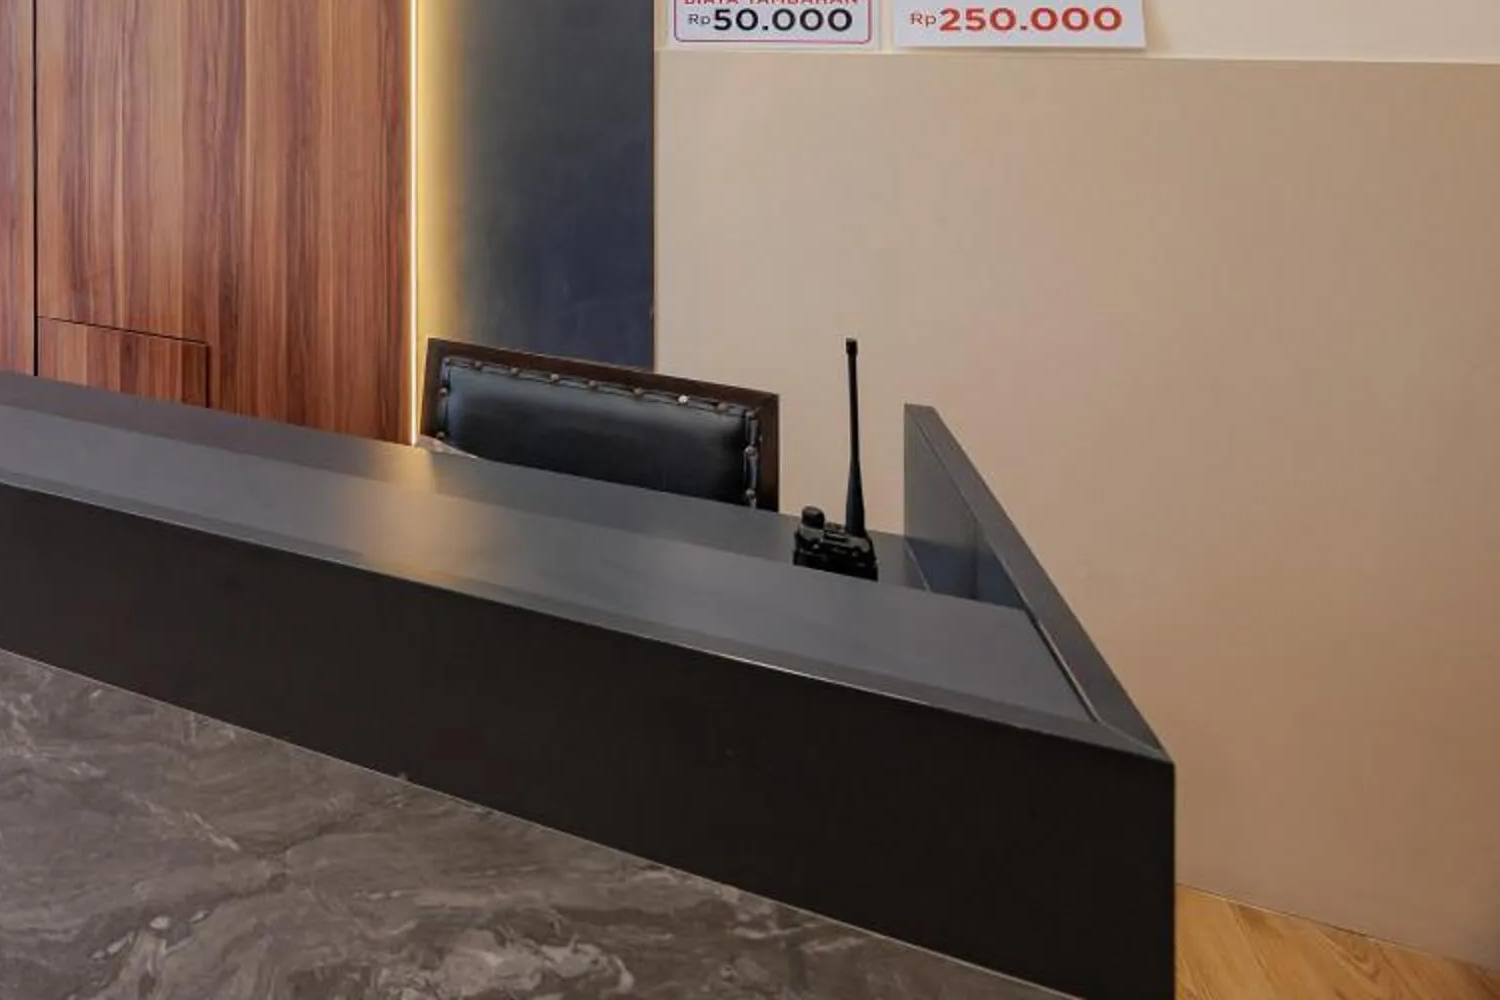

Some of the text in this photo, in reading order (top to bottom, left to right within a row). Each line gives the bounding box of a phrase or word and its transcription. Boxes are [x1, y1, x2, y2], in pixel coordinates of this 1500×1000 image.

[688, 8, 852, 32] Rp 50.000
[911, 7, 1122, 31] Rp 250.000
